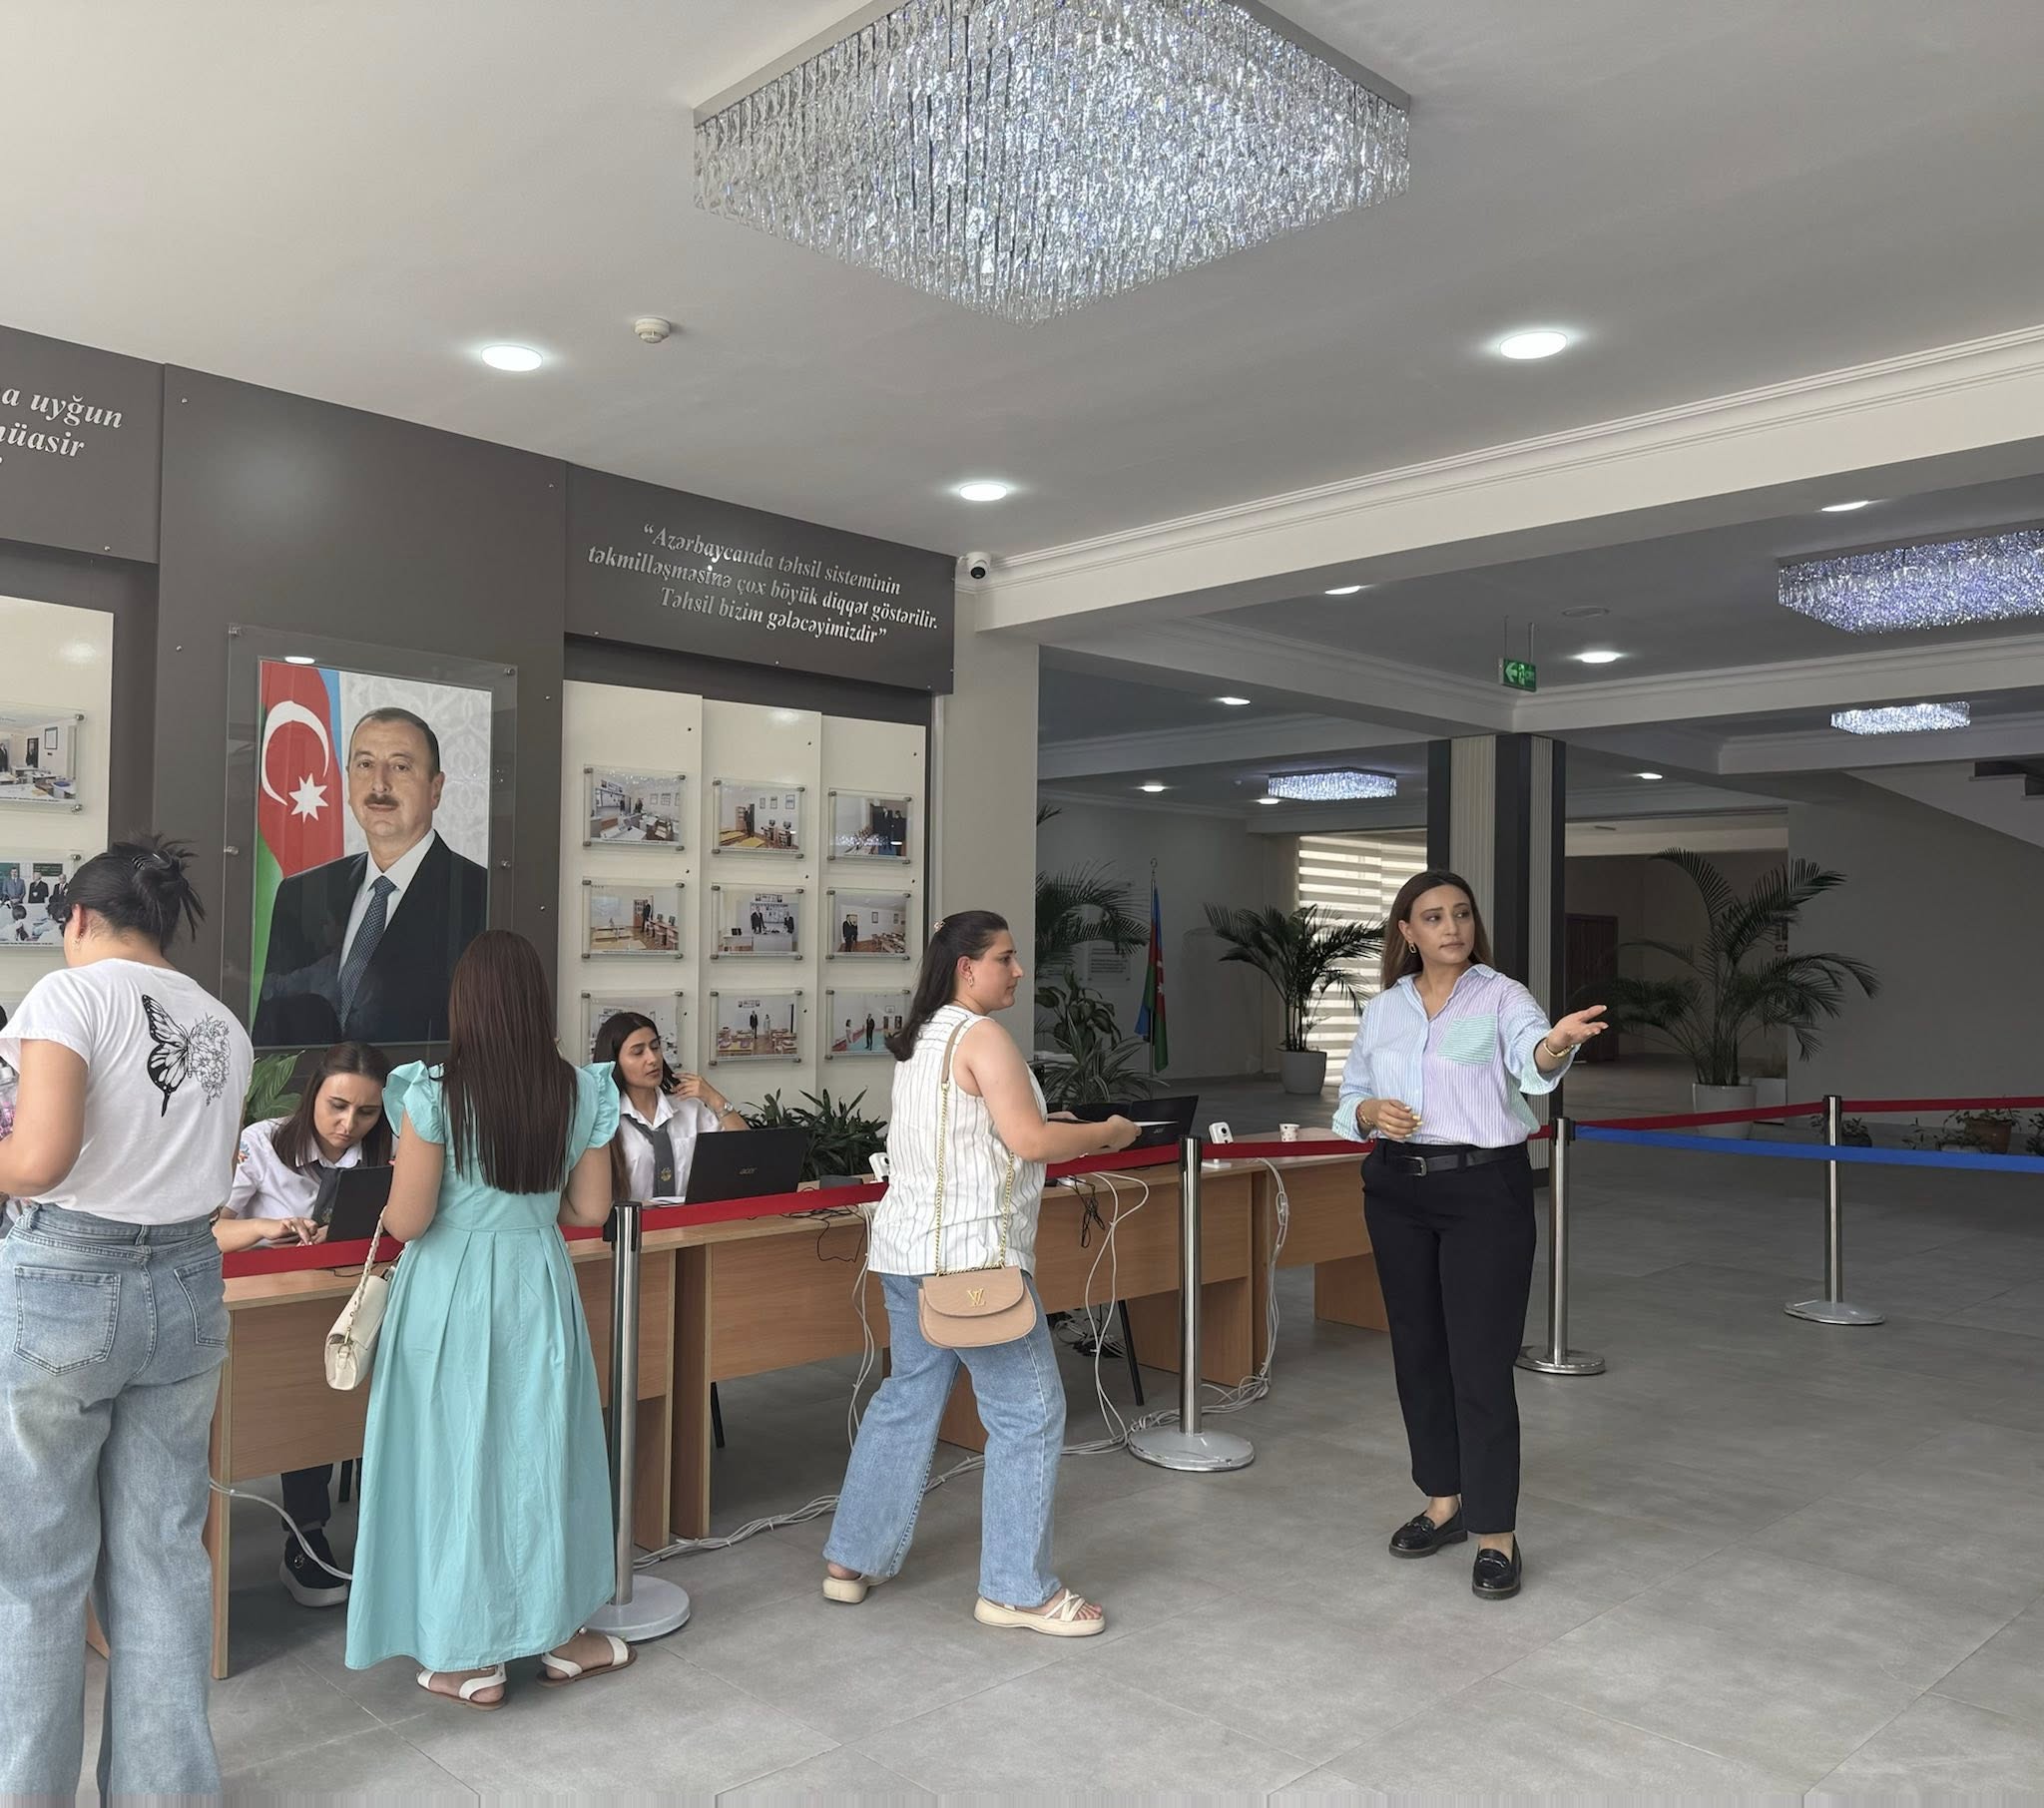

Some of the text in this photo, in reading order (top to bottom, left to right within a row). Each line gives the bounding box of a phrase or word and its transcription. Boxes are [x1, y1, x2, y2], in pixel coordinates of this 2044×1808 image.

[30, 394, 122, 429] uyğun
[0, 422, 85, 457] üasir
[588, 546, 938, 630] təkmilləşməsinə çox böyük diqqət göstərilir.
[778, 556, 822, 579] təhsil
[824, 565, 902, 596] sisteminin
[661, 587, 887, 644] Təhsil bizim gələcəyimizdir”
